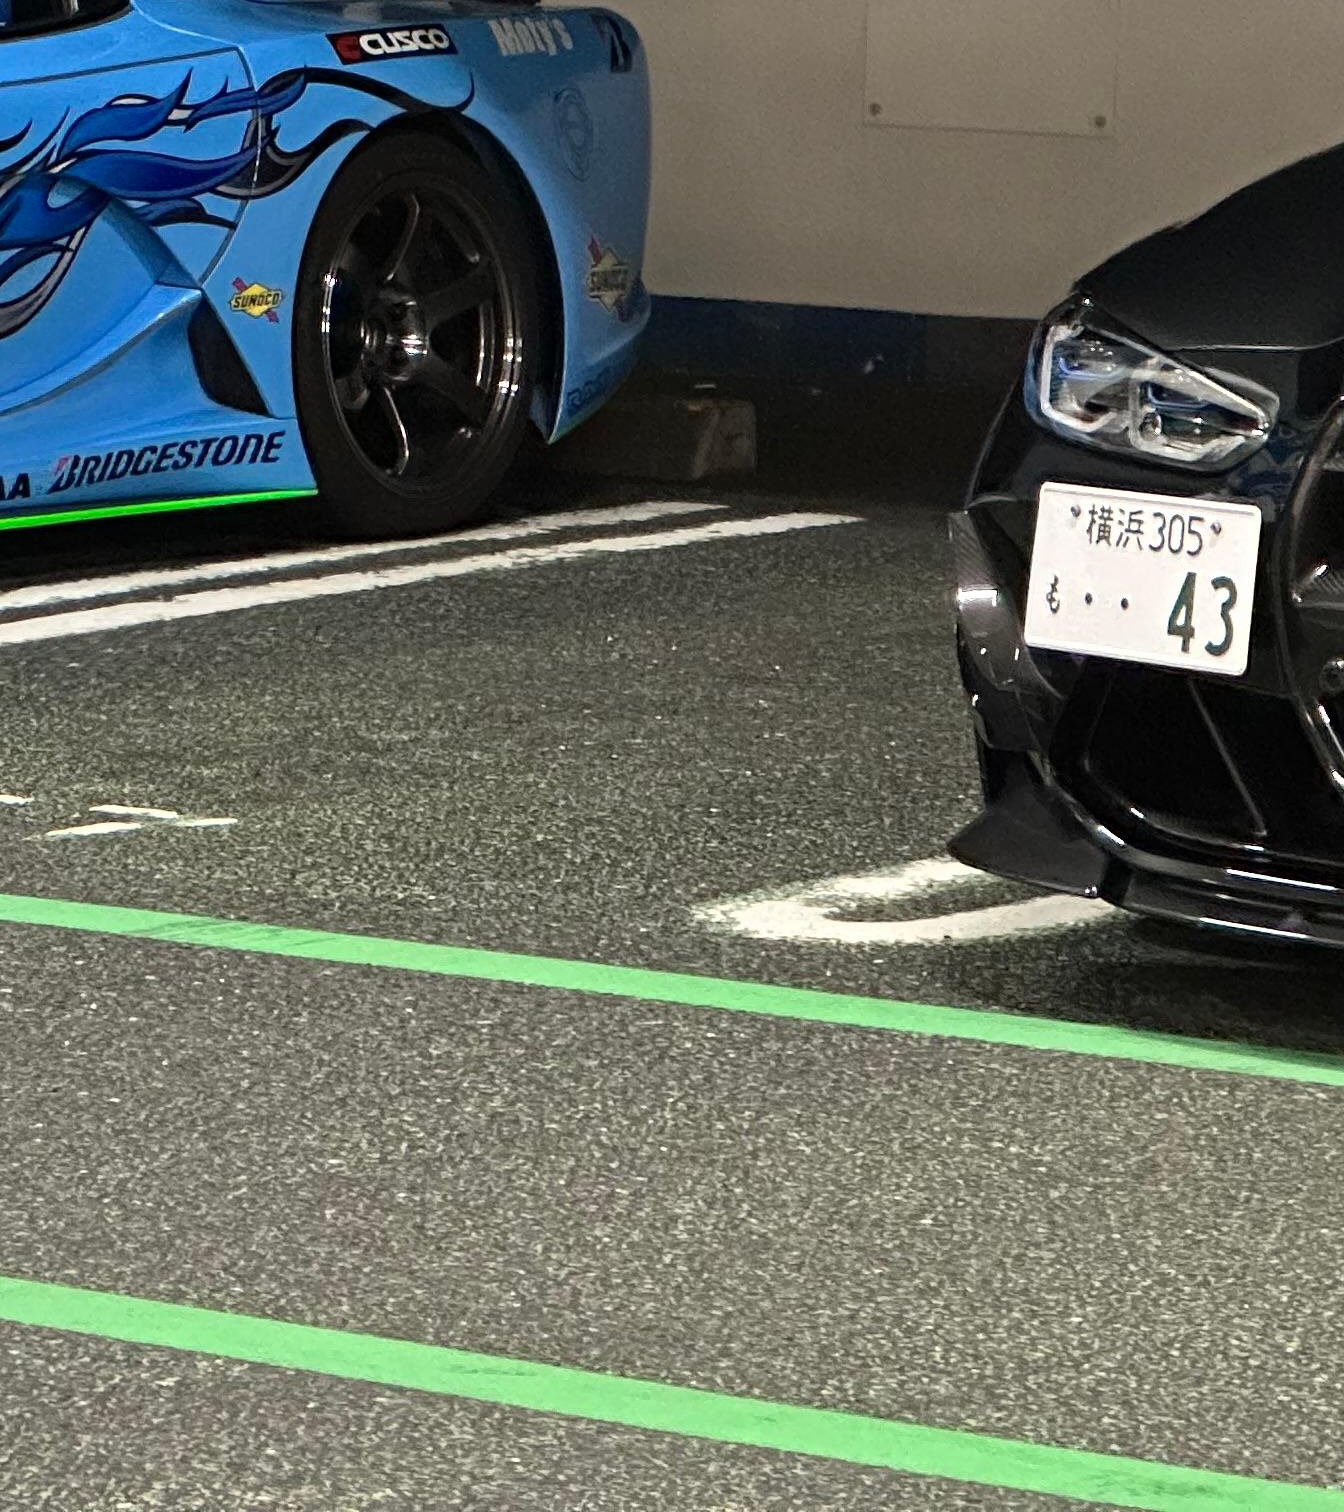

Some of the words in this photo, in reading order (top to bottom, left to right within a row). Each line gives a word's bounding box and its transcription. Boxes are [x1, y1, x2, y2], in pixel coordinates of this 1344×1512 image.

[359, 28, 451, 56] CUSCO
[233, 292, 280, 309] SUNOCO
[47, 429, 286, 496] BRIDGESTONE
